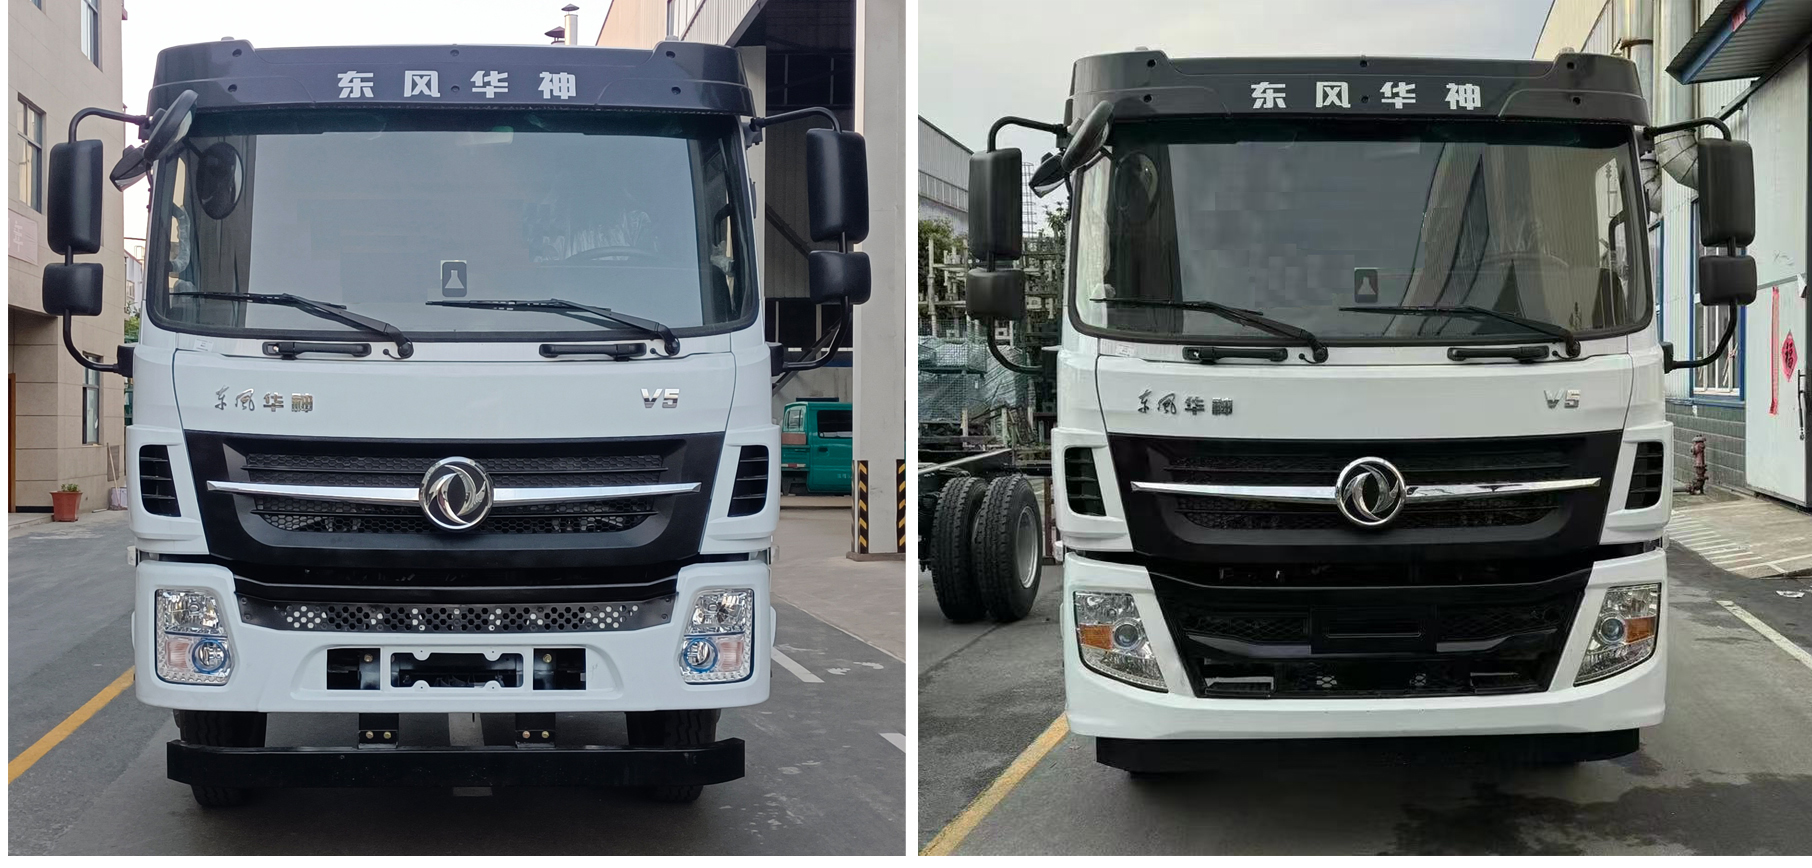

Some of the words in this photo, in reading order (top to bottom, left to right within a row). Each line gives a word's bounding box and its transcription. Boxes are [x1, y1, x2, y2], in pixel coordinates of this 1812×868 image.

[338, 71, 577, 100] 东风华神
[1251, 82, 1481, 110] 东风华神
[640, 388, 680, 408] V5
[1543, 389, 1581, 409] V5
